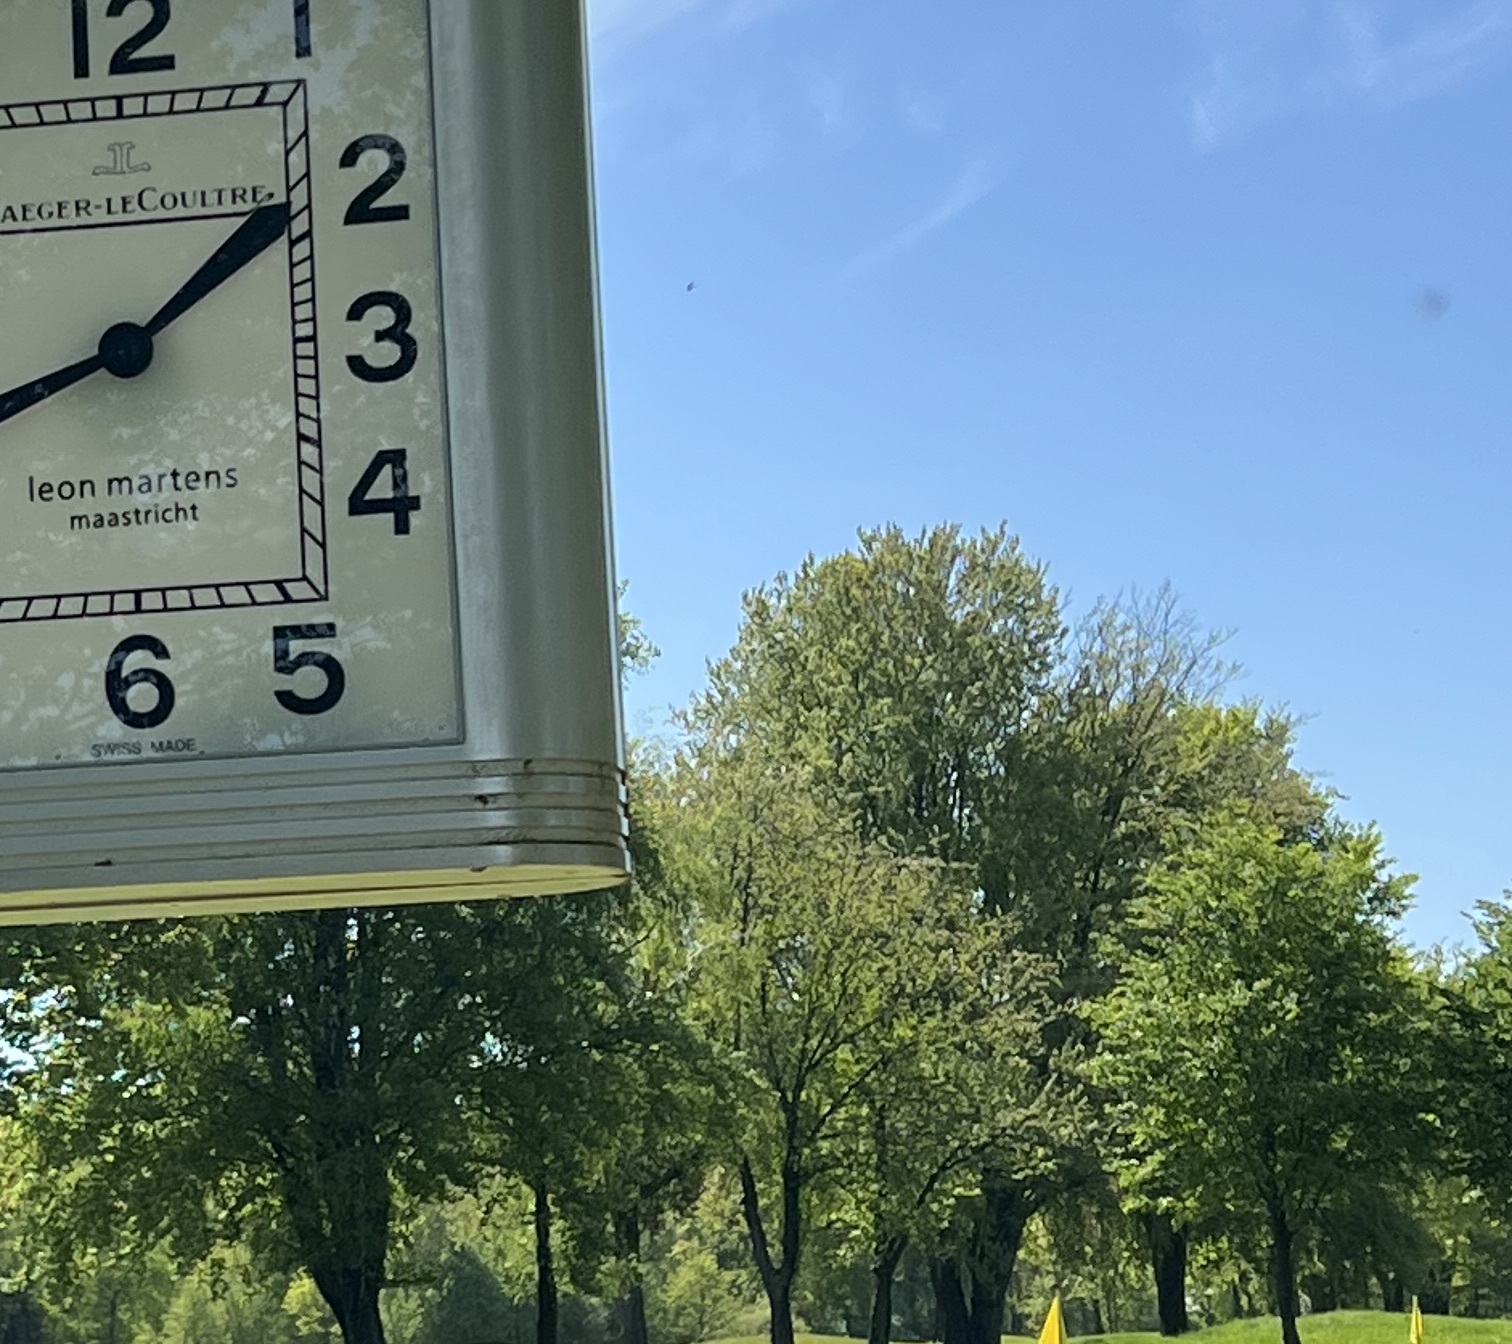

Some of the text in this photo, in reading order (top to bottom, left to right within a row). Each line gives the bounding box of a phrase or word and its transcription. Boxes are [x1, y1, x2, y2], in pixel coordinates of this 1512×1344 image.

[338, 134, 410, 226] 2
[345, 291, 418, 383] 3
[28, 466, 239, 503] leon martens
[69, 502, 199, 531] maastricht
[347, 448, 421, 536] 4
[105, 634, 176, 730] 6
[272, 622, 346, 715] 5
[91, 738, 197, 758] SWISS MADE
